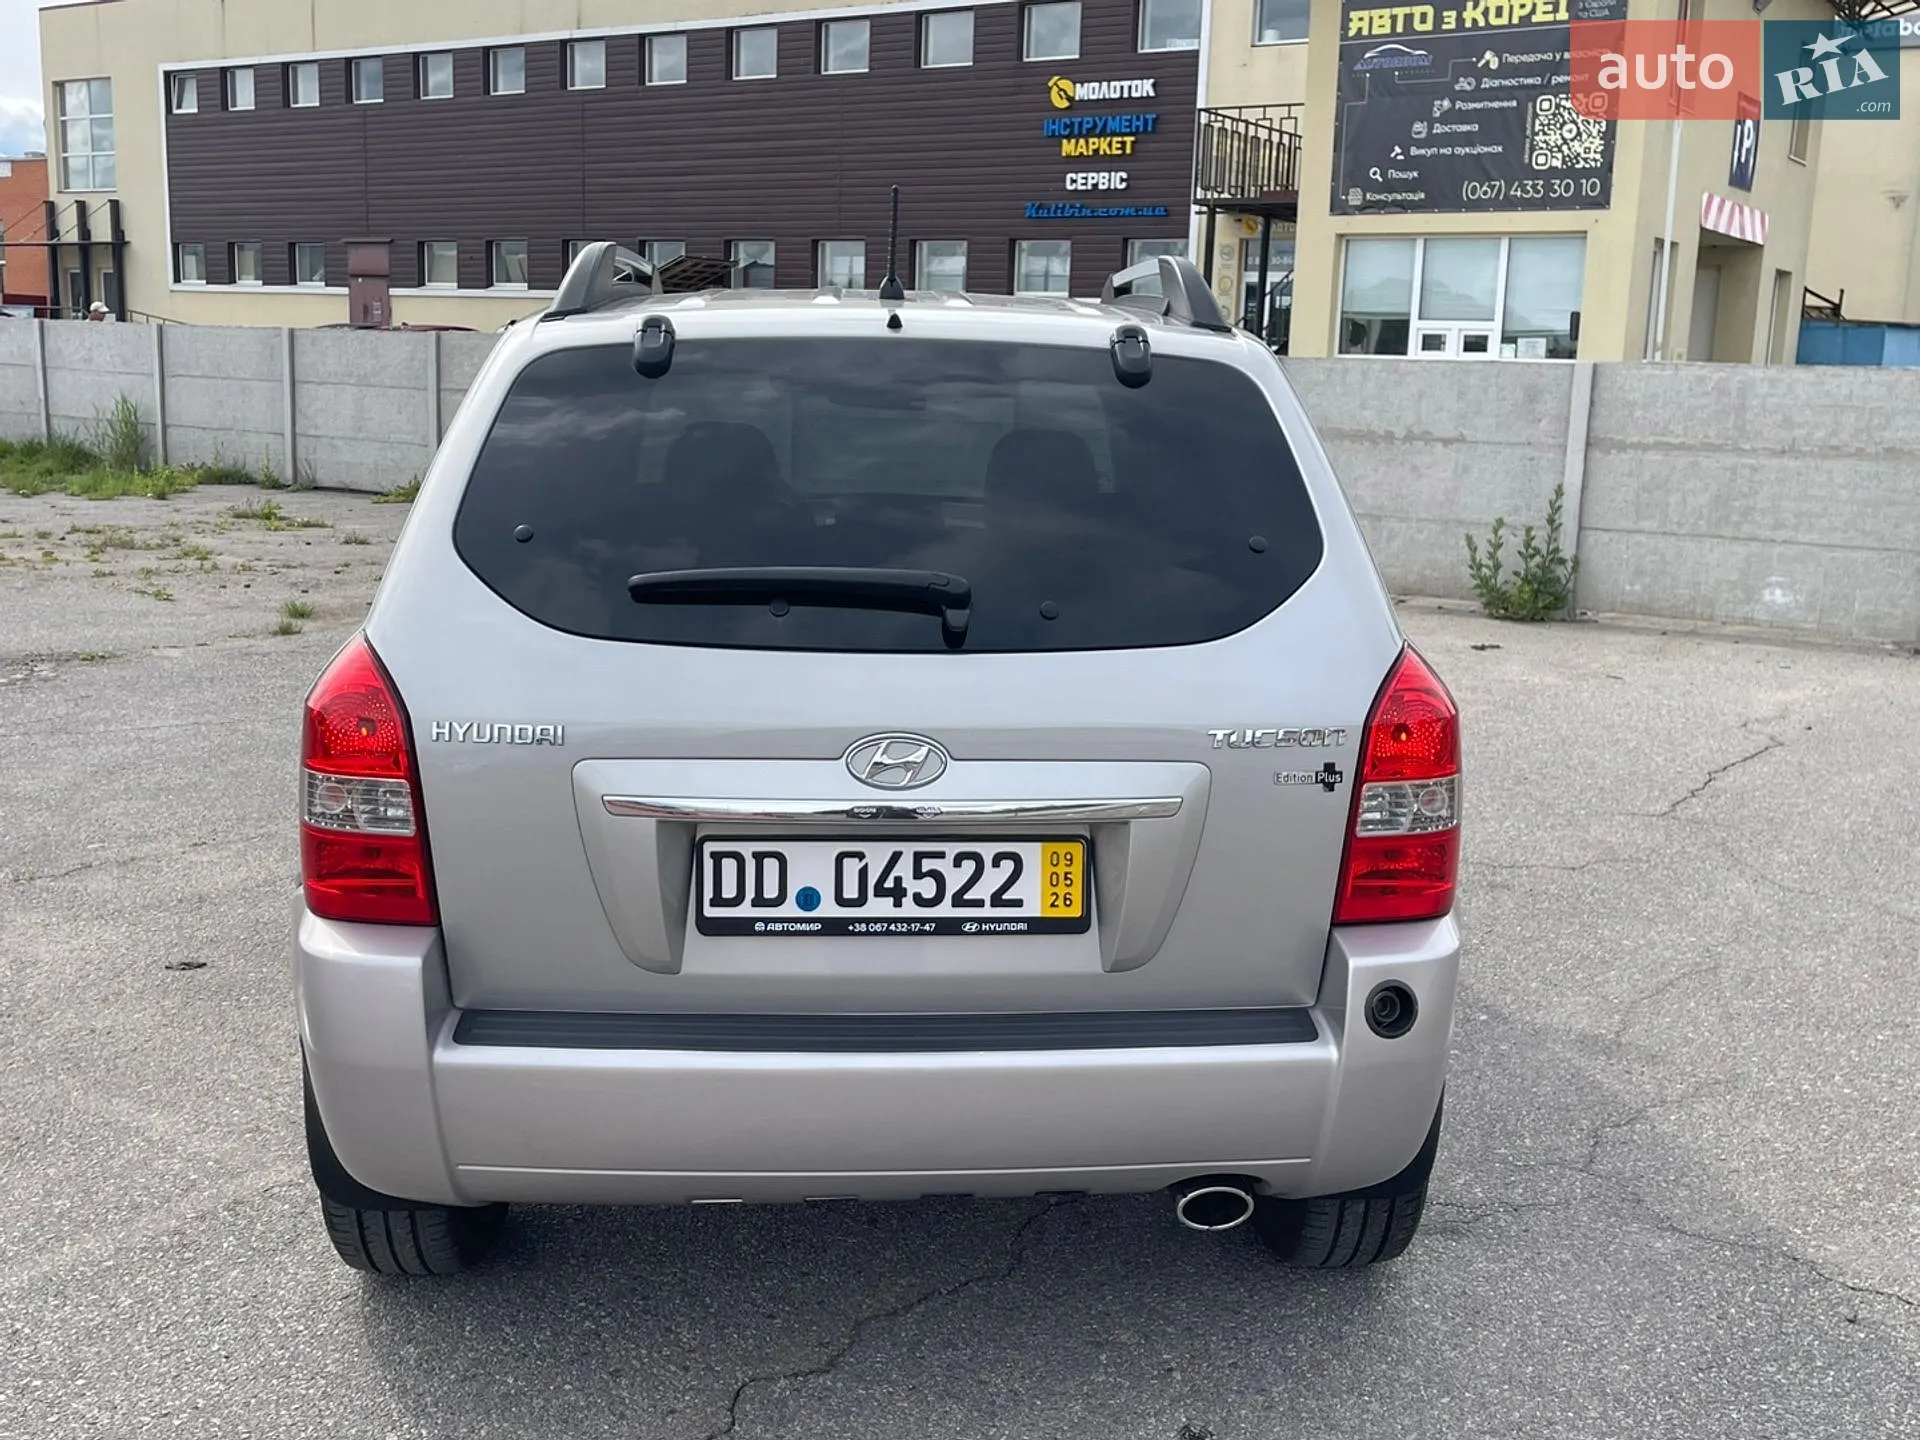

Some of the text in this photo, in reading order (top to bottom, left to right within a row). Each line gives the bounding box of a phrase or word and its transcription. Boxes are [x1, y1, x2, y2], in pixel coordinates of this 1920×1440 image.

[1502, 52, 1553, 64] Передача
[1075, 78, 1156, 101] МОЛОТОК
[1480, 74, 1542, 89] Діагностика
[1455, 99, 1518, 111] Розмитнення
[1043, 113, 1158, 137] ІНСТРУМЕНТ
[1432, 122, 1479, 135] Доставка
[1061, 136, 1136, 157] МАРКЕТ
[1410, 145, 1438, 158] Викуп
[1065, 171, 1128, 191] СЕРВІС
[1387, 168, 1420, 181] Пошук
[1462, 177, 1601, 201] (067) 433 30 10
[1024, 201, 1168, 218] Kulibin.com.ua
[431, 721, 565, 747] HYUNDAI
[1207, 727, 1347, 750] TUCSON
[1275, 772, 1342, 784] Edition Plus
[1049, 851, 1074, 868] 09
[709, 850, 1024, 908] DD 04522
[1049, 871, 1074, 888] 05
[1049, 891, 1074, 908] 26
[766, 922, 822, 932] АВТОМИР
[847, 922, 936, 932] +38 067 432-17-47
[981, 922, 1028, 932] HYUNDAI
